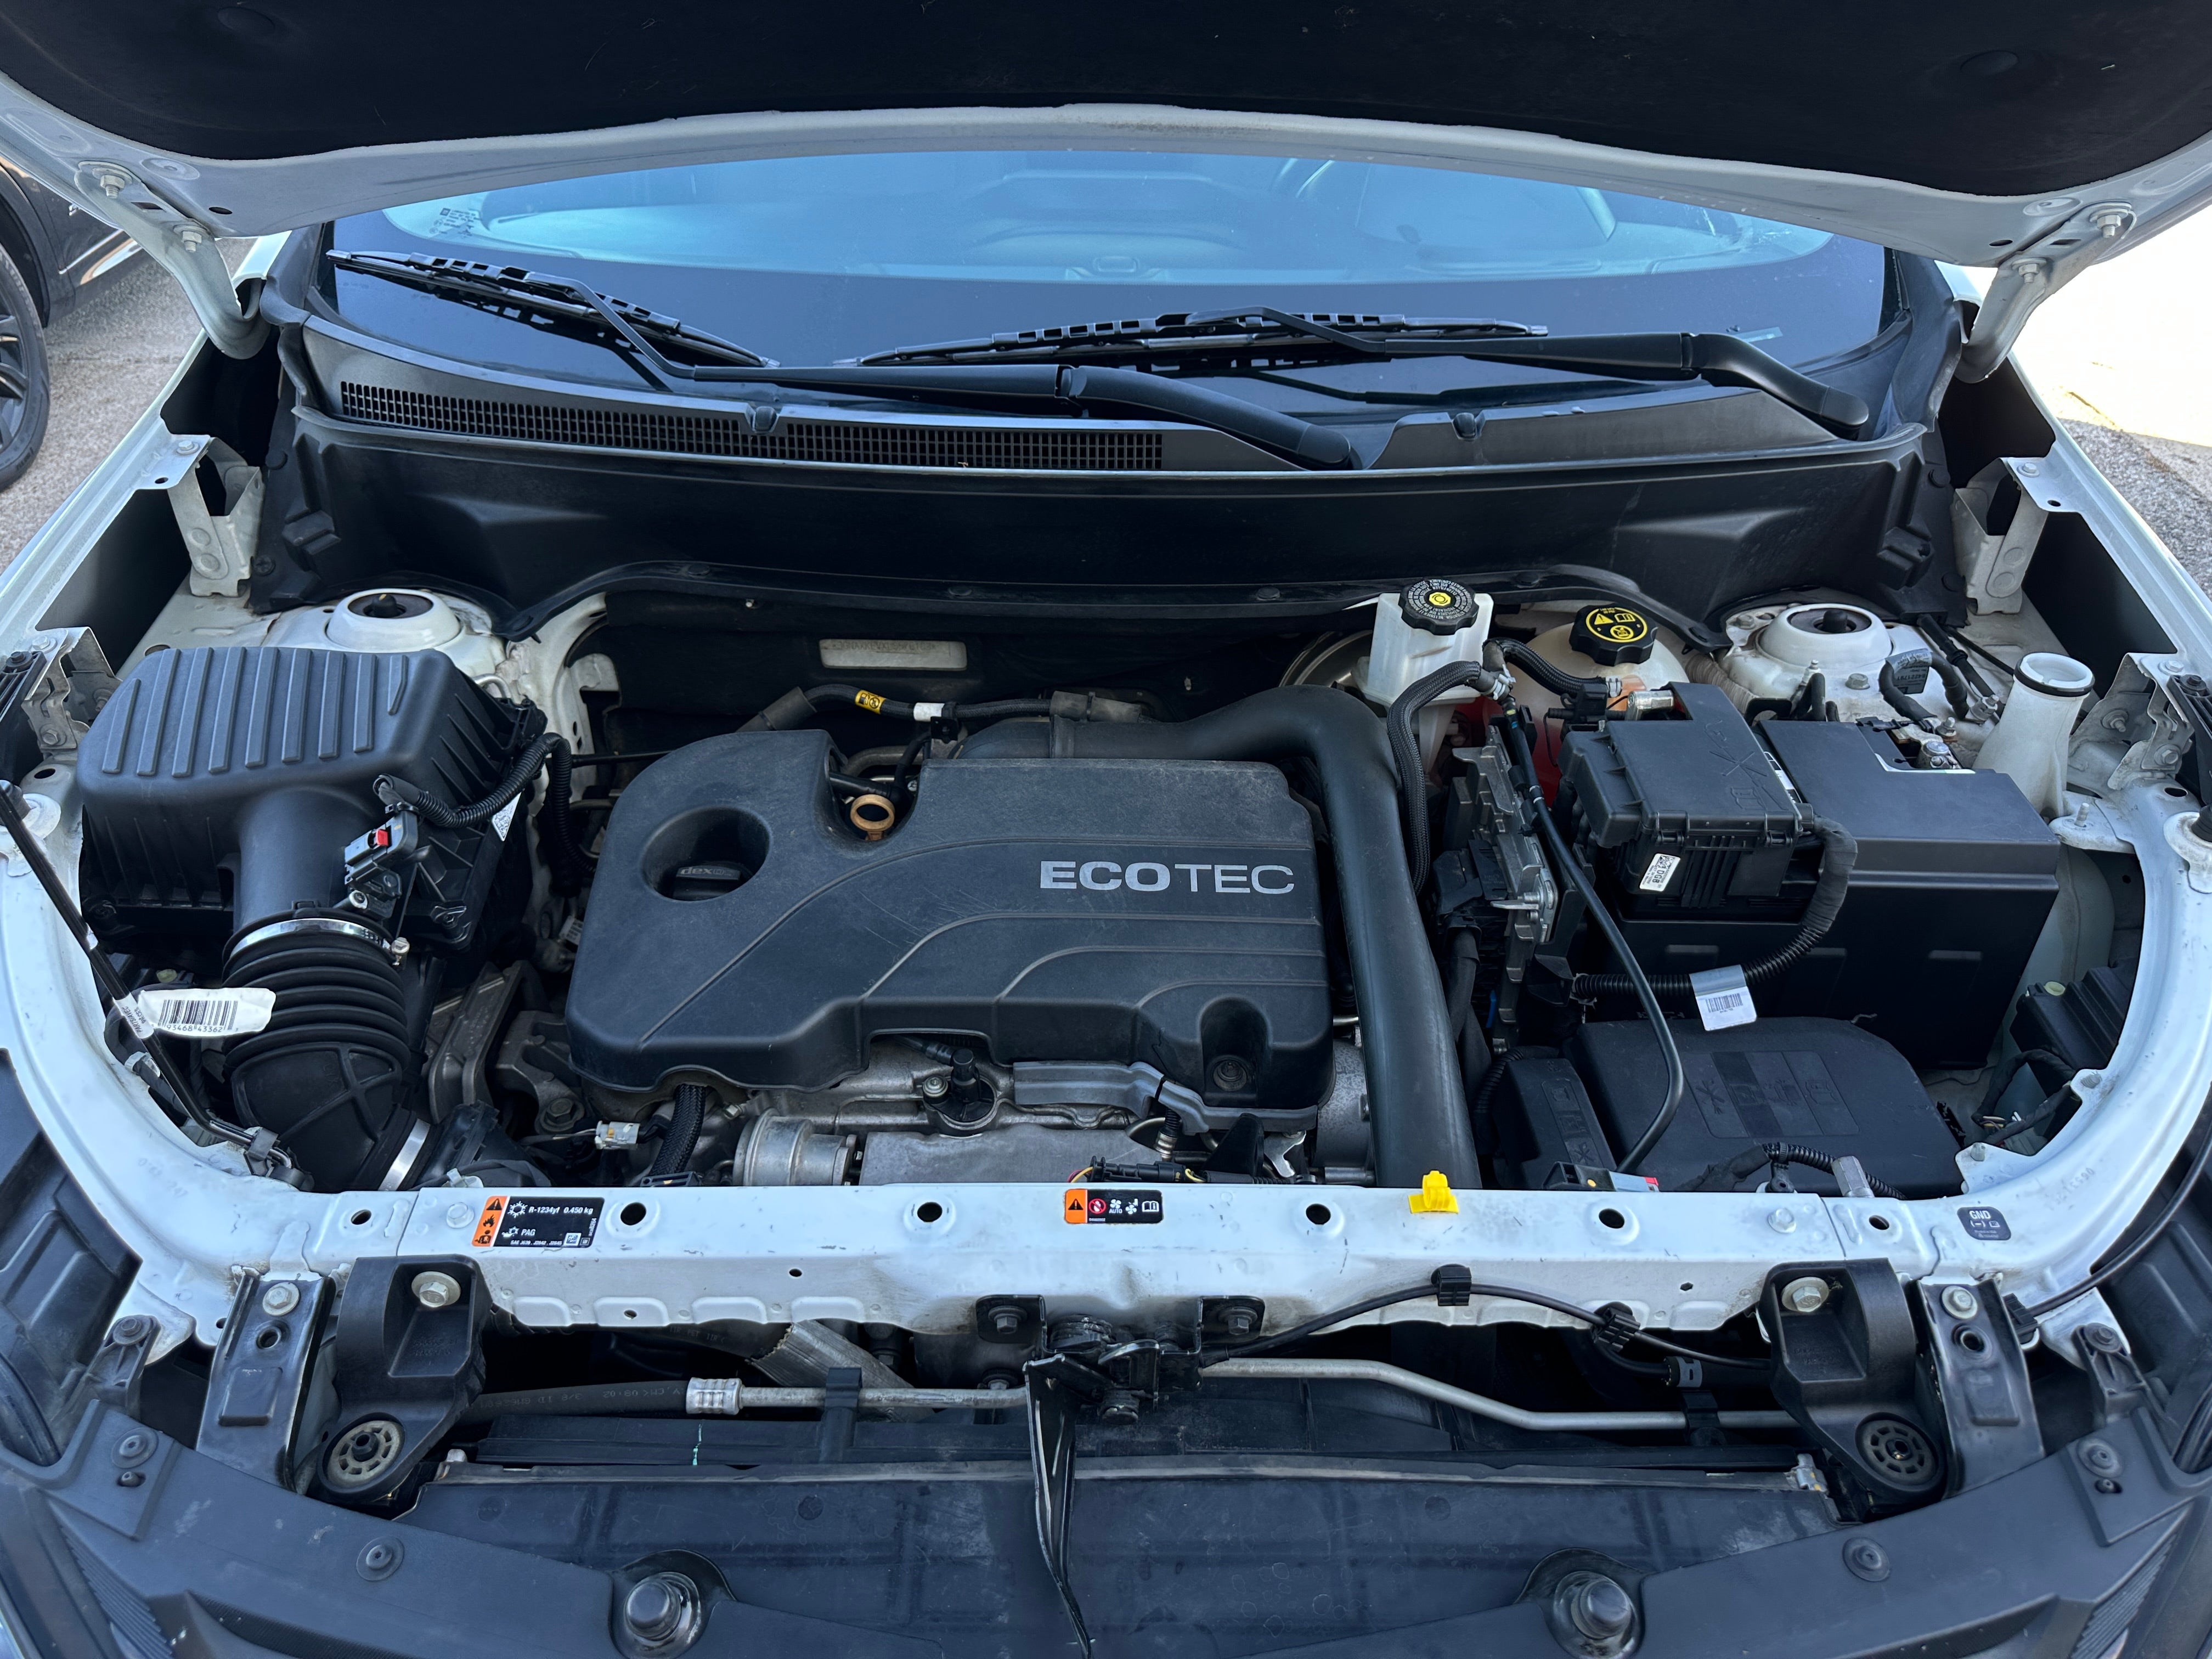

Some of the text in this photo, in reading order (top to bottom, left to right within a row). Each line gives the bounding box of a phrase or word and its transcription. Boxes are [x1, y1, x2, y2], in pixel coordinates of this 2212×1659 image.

[1040, 860, 1295, 895] ECOTEC
[528, 1206, 560, 1215] R-1234yf
[584, 1206, 594, 1215] kg
[1968, 1210, 1991, 1220] GND
